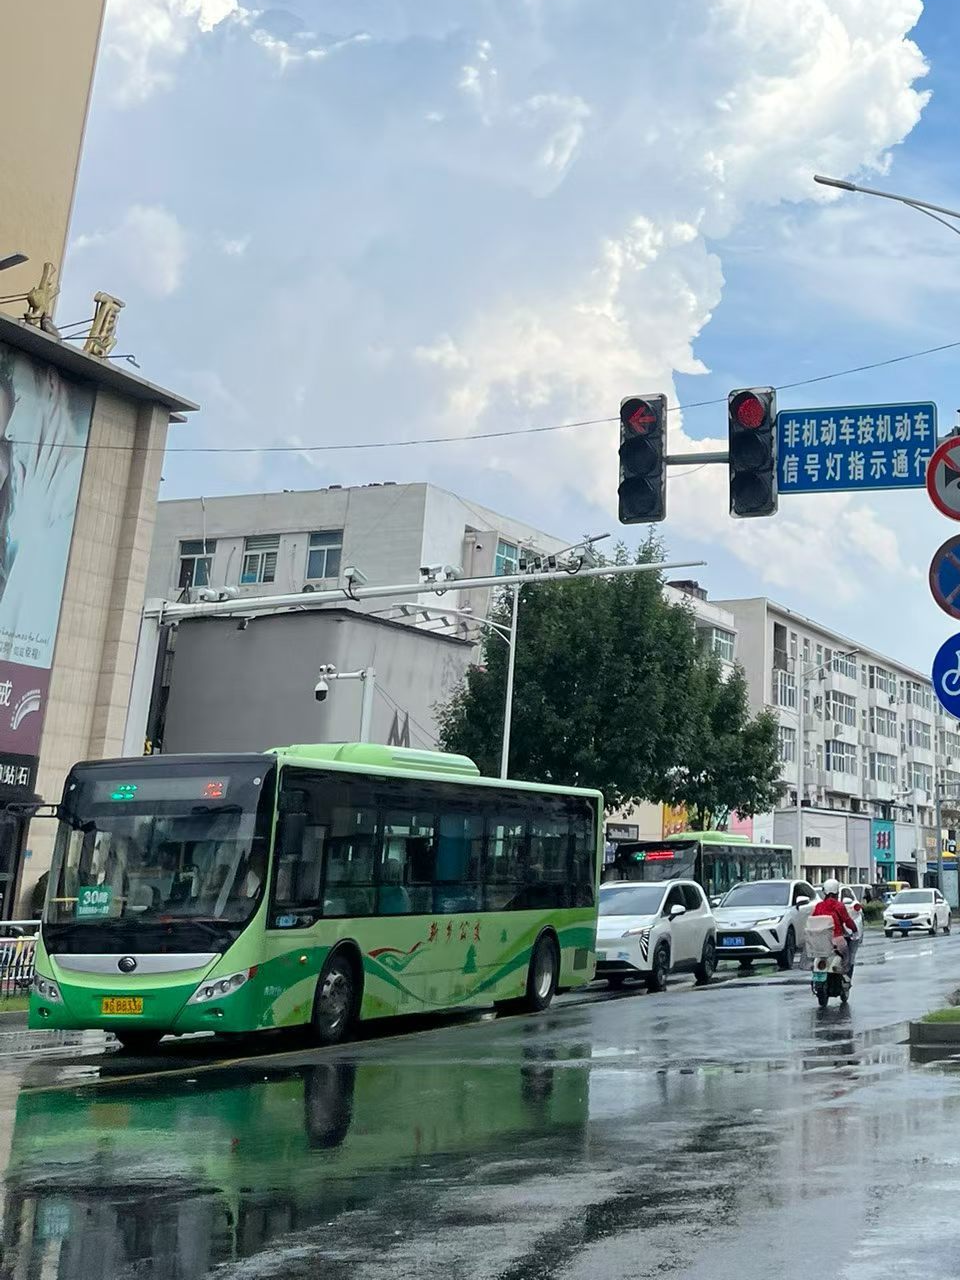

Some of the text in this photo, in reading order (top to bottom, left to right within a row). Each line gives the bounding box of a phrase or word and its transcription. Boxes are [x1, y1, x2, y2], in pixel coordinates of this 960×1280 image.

[783, 411, 931, 449] 非机动车按机动车
[782, 447, 931, 484] 信号灯指示通行
